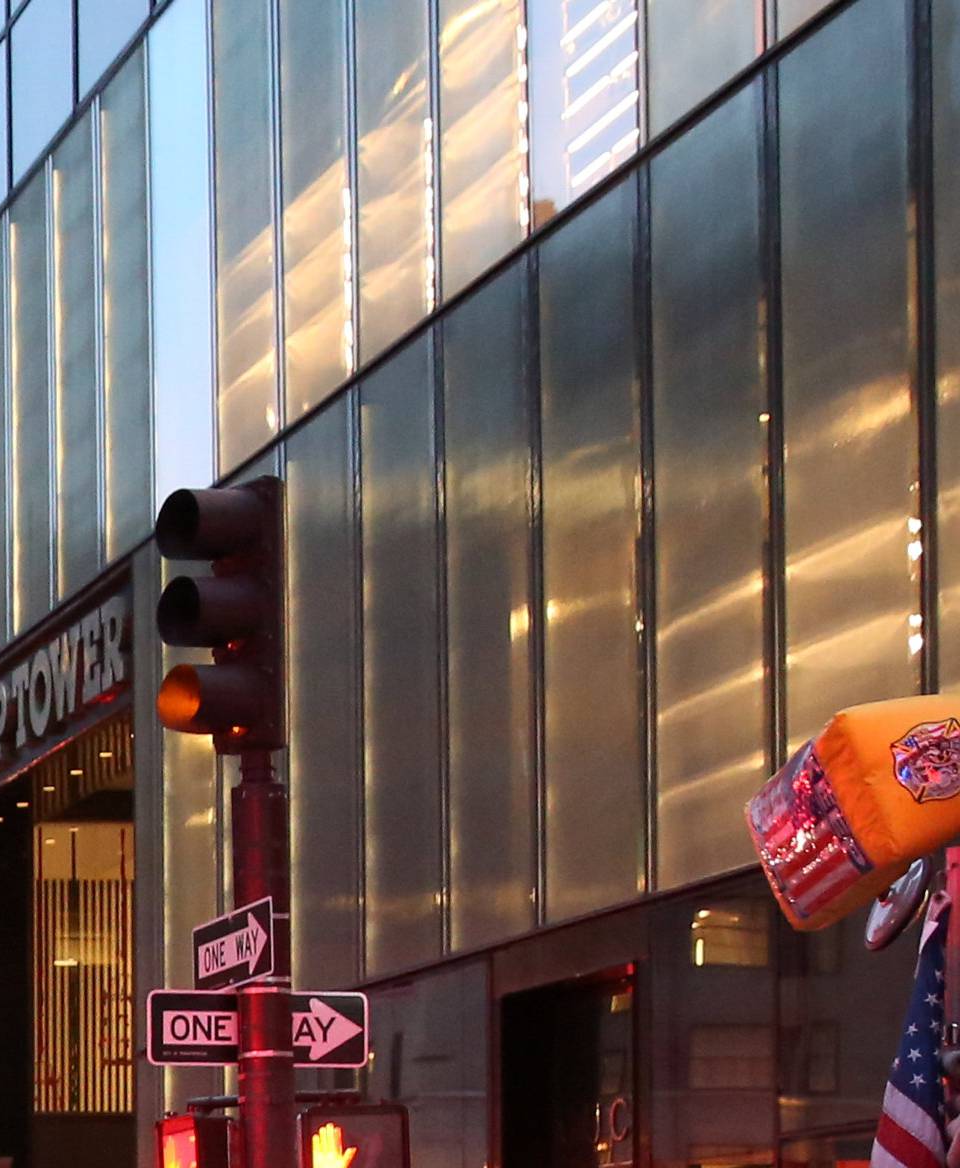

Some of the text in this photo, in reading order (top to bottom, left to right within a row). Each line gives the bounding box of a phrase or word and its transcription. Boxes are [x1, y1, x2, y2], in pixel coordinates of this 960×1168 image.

[12, 596, 125, 748] TOWER
[204, 927, 260, 973] ONE WAY
[171, 1015, 336, 1042] ONE AY
